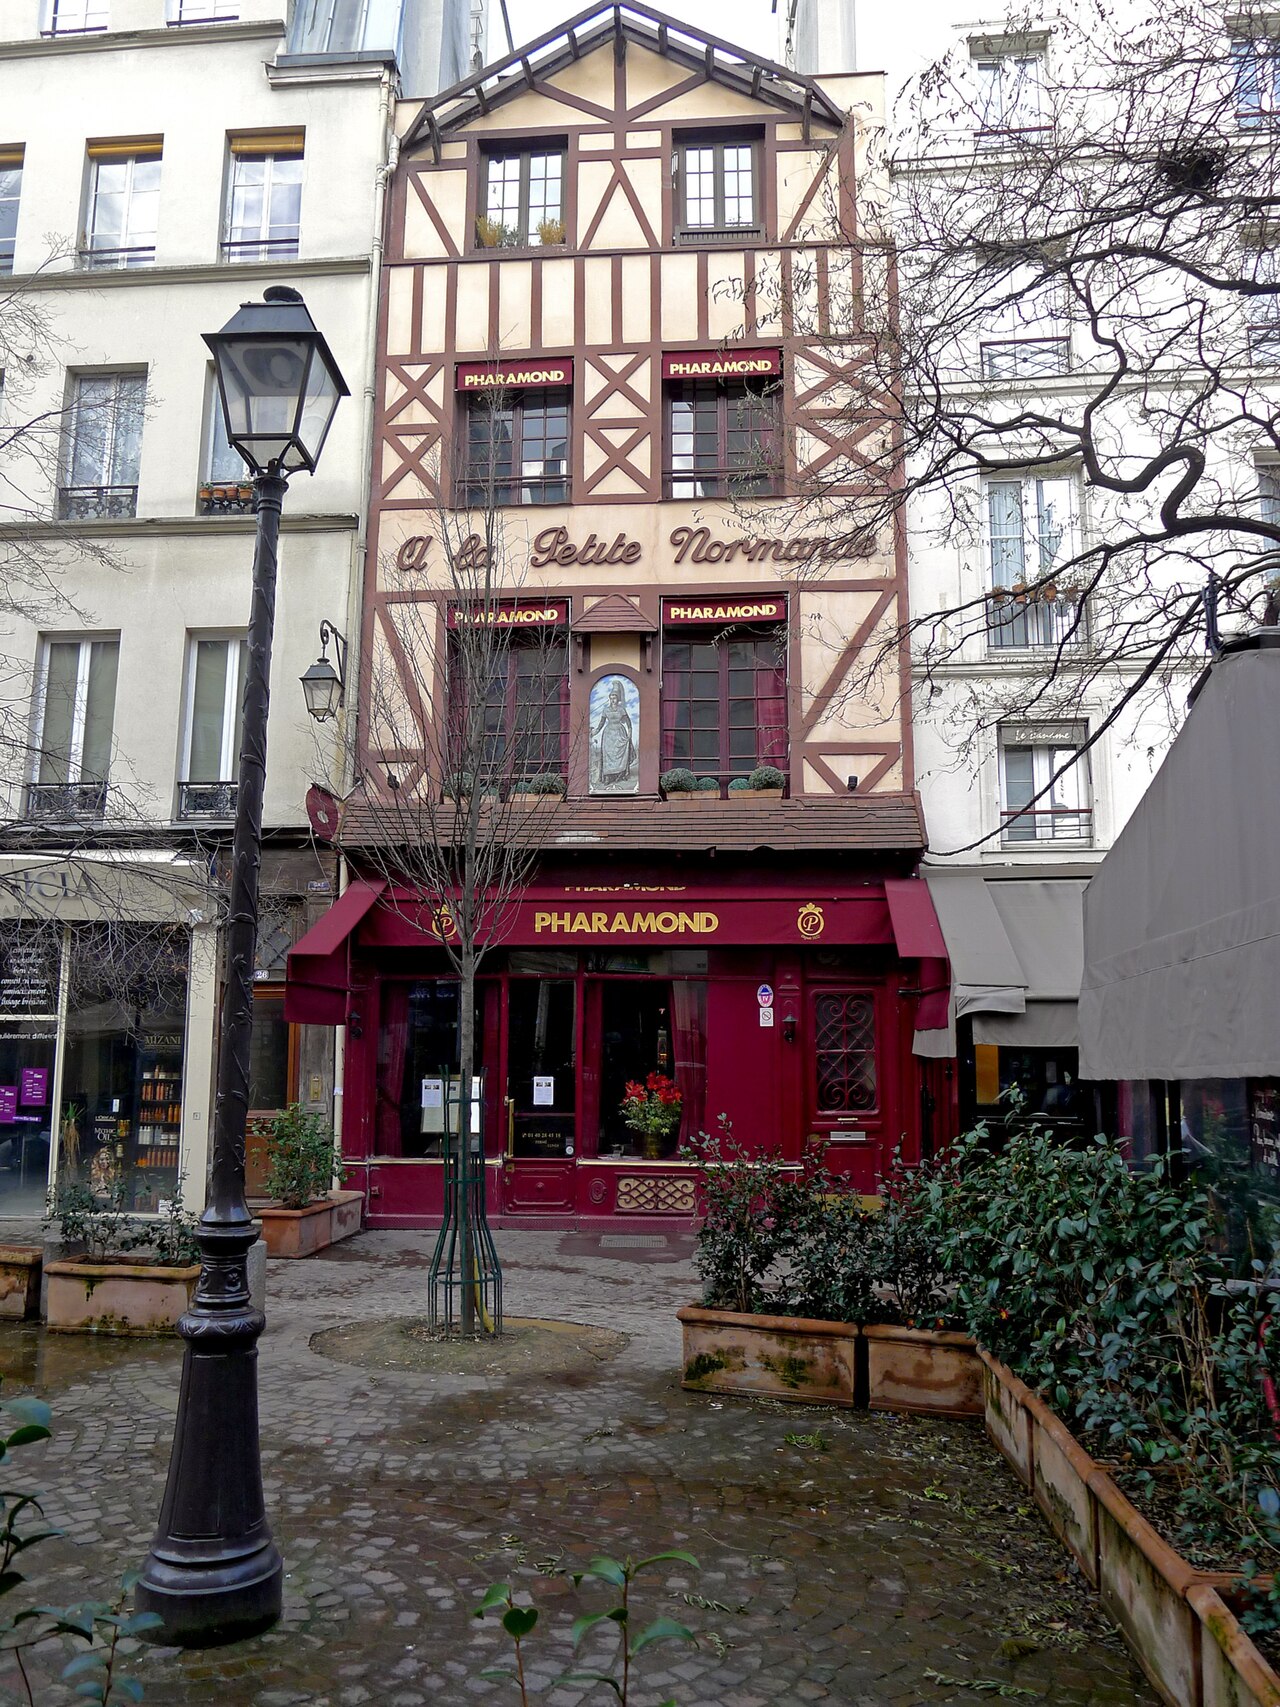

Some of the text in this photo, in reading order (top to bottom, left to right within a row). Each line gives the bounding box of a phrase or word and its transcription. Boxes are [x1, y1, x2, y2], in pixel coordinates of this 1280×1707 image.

[669, 358, 772, 376] PHARAMOND
[463, 369, 565, 387] PHARAMOND
[452, 533, 496, 571] la
[530, 525, 642, 569] Petite
[453, 608, 559, 624] PHARAMOND
[669, 603, 778, 619] PHARAMOND
[533, 911, 720, 934] PHARAMOND
[256, 970, 268, 979] 26
[145, 1035, 181, 1045] MIZANI
